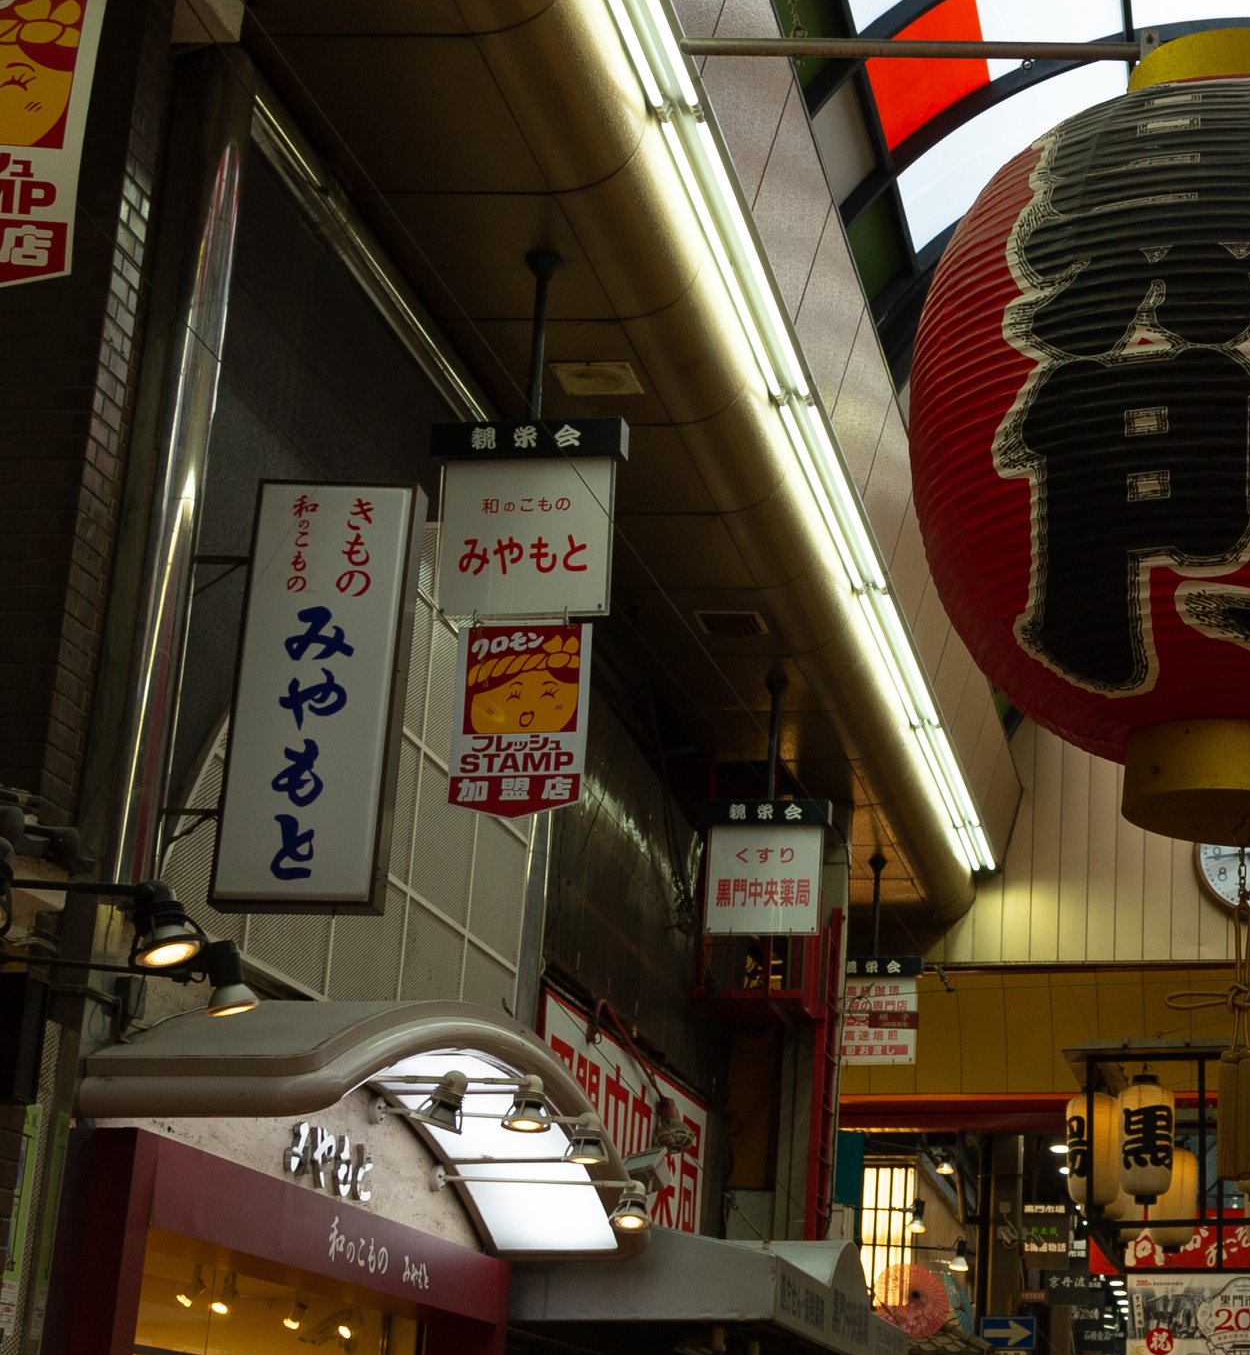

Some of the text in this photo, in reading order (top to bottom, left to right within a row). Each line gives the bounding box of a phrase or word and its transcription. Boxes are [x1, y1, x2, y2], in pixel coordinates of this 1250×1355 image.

[471, 424, 581, 451] 親栄会
[482, 497, 571, 514] 和のこもの
[287, 495, 319, 592] 和のこもの
[336, 498, 373, 597] きもの
[459, 534, 588, 575] みやもと
[471, 632, 545, 661] クロモン
[270, 606, 354, 880] みやもと
[471, 736, 562, 752] フレッシュ
[460, 752, 573, 773] STAMP
[457, 777, 573, 802] 加盟店
[730, 803, 803, 820] 親栄会
[736, 847, 795, 863] くすり
[1217, 866, 1228, 882] 8
[716, 878, 811, 907] 黒門中央薬局
[329, 1216, 389, 1275] 和のこもの
